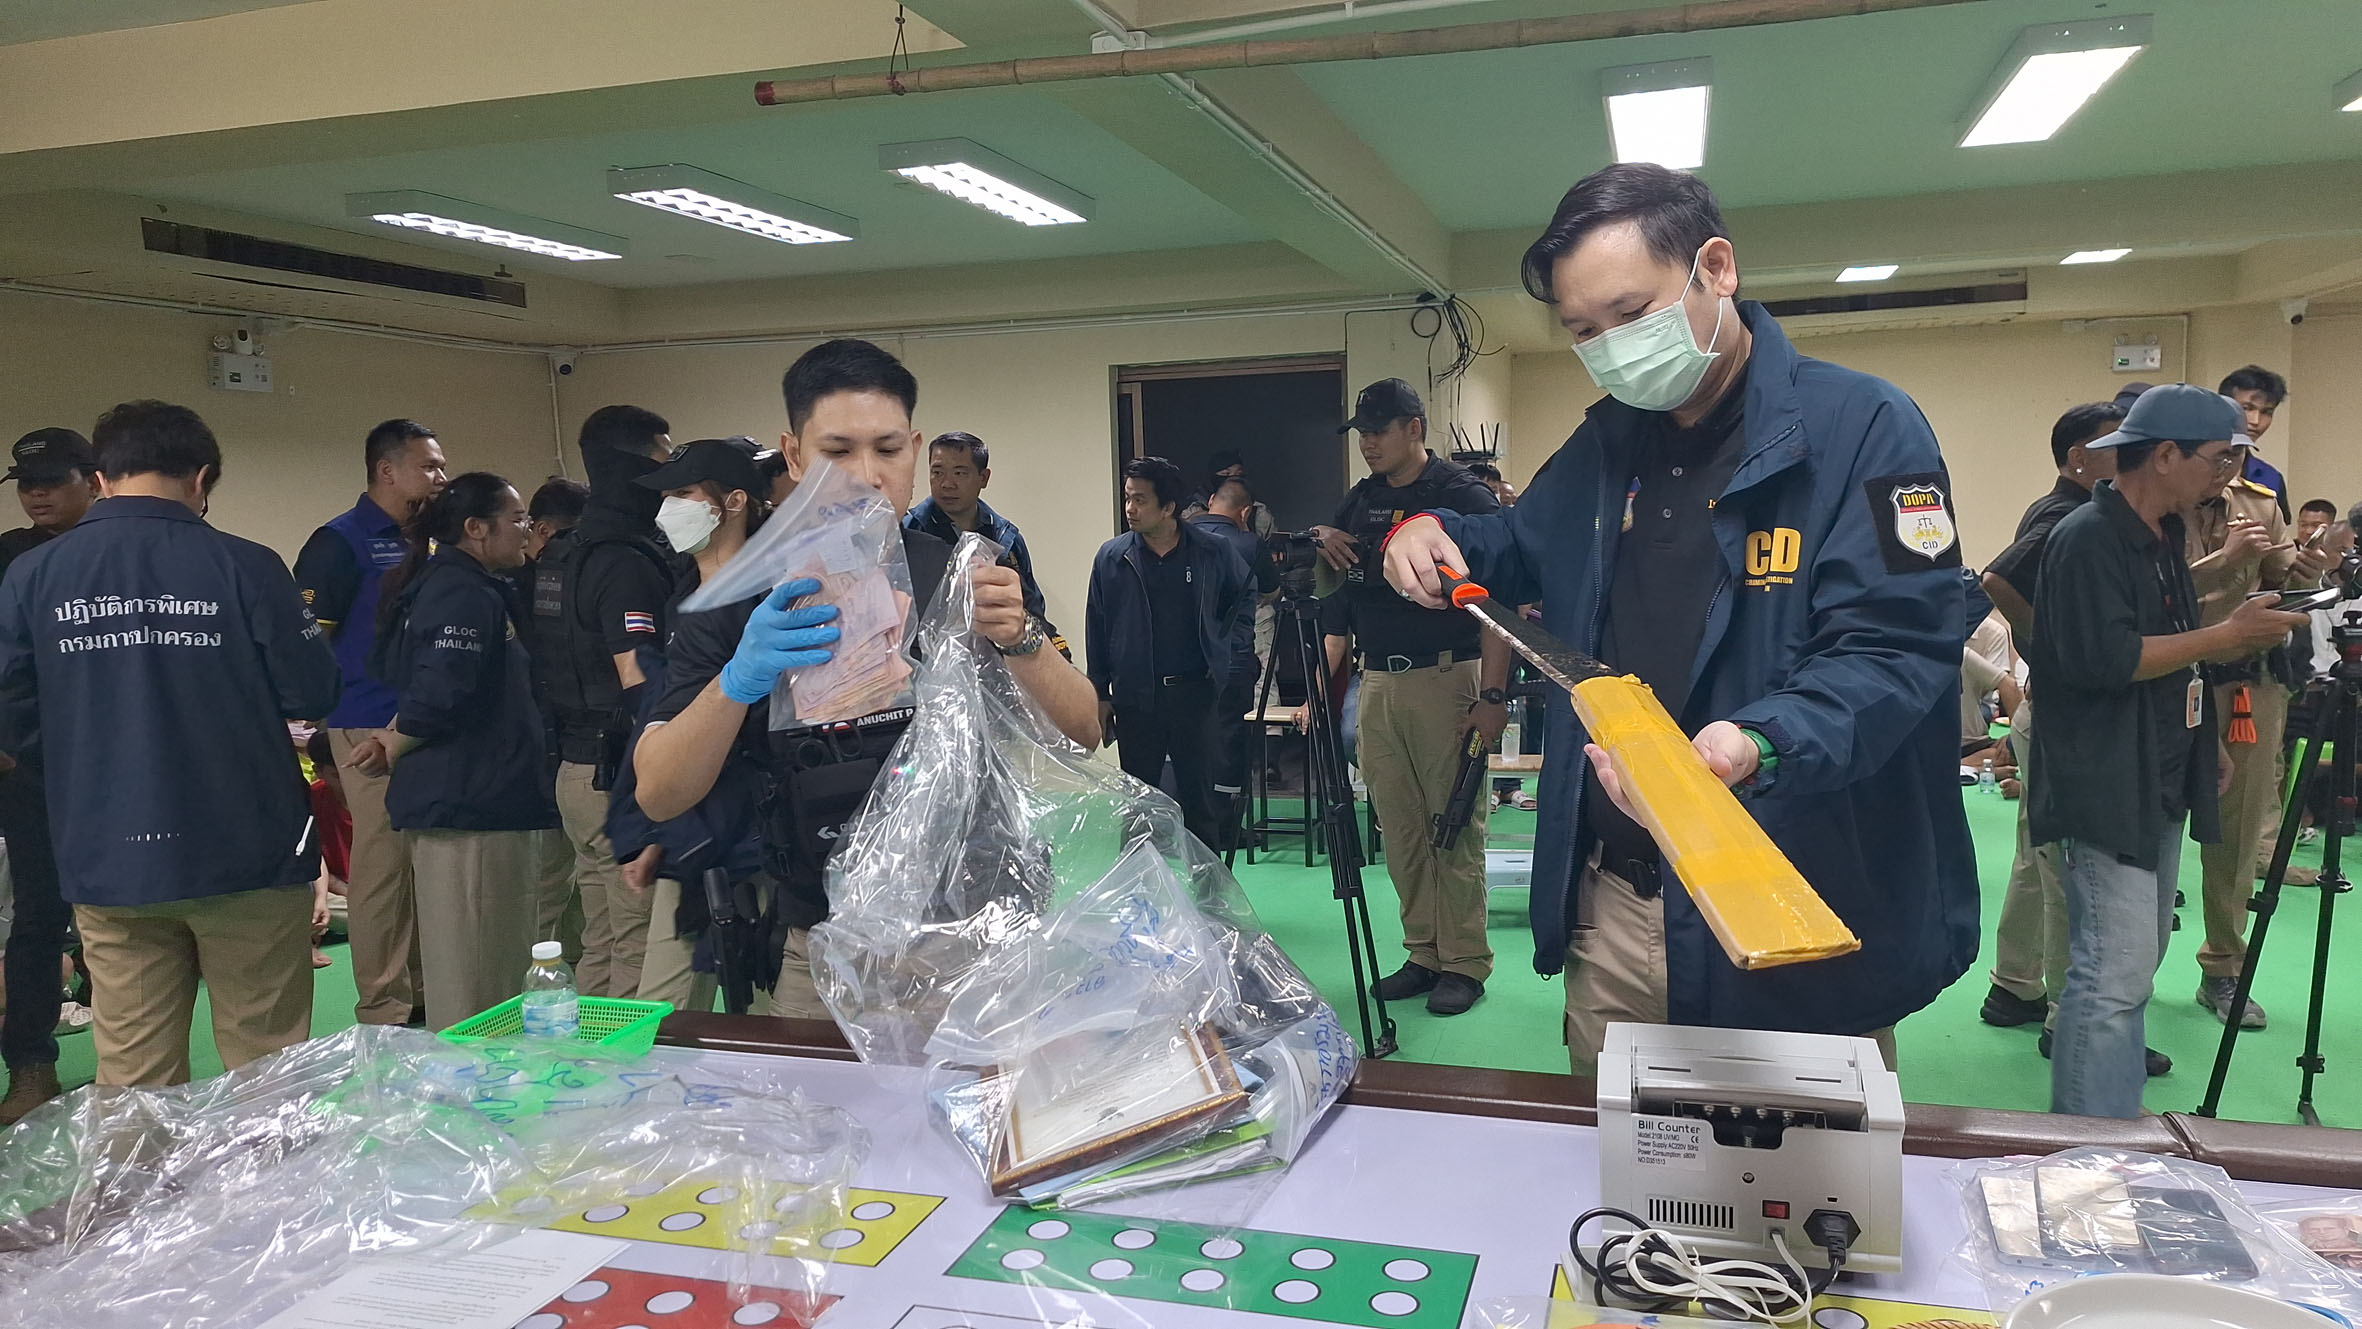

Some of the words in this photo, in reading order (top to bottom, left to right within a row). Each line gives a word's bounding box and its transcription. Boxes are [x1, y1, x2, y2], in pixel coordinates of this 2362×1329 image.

[1902, 493, 1935, 507] DOPA
[1745, 528, 1801, 576] CD
[1922, 540, 1939, 550] CID
[54, 594, 219, 625] ปฏิบัติการพิเศษ
[444, 625, 478, 638] GLOC
[58, 625, 222, 653] กรมการปกครอง
[856, 710, 903, 727] ANUCHIT
[1638, 1120, 1654, 1131] Bill
[1657, 1121, 1701, 1134] Counter
[1637, 1139, 1652, 1148] Power
[1652, 1141, 1667, 1150] Supply
[1637, 1148, 1652, 1156] Power
